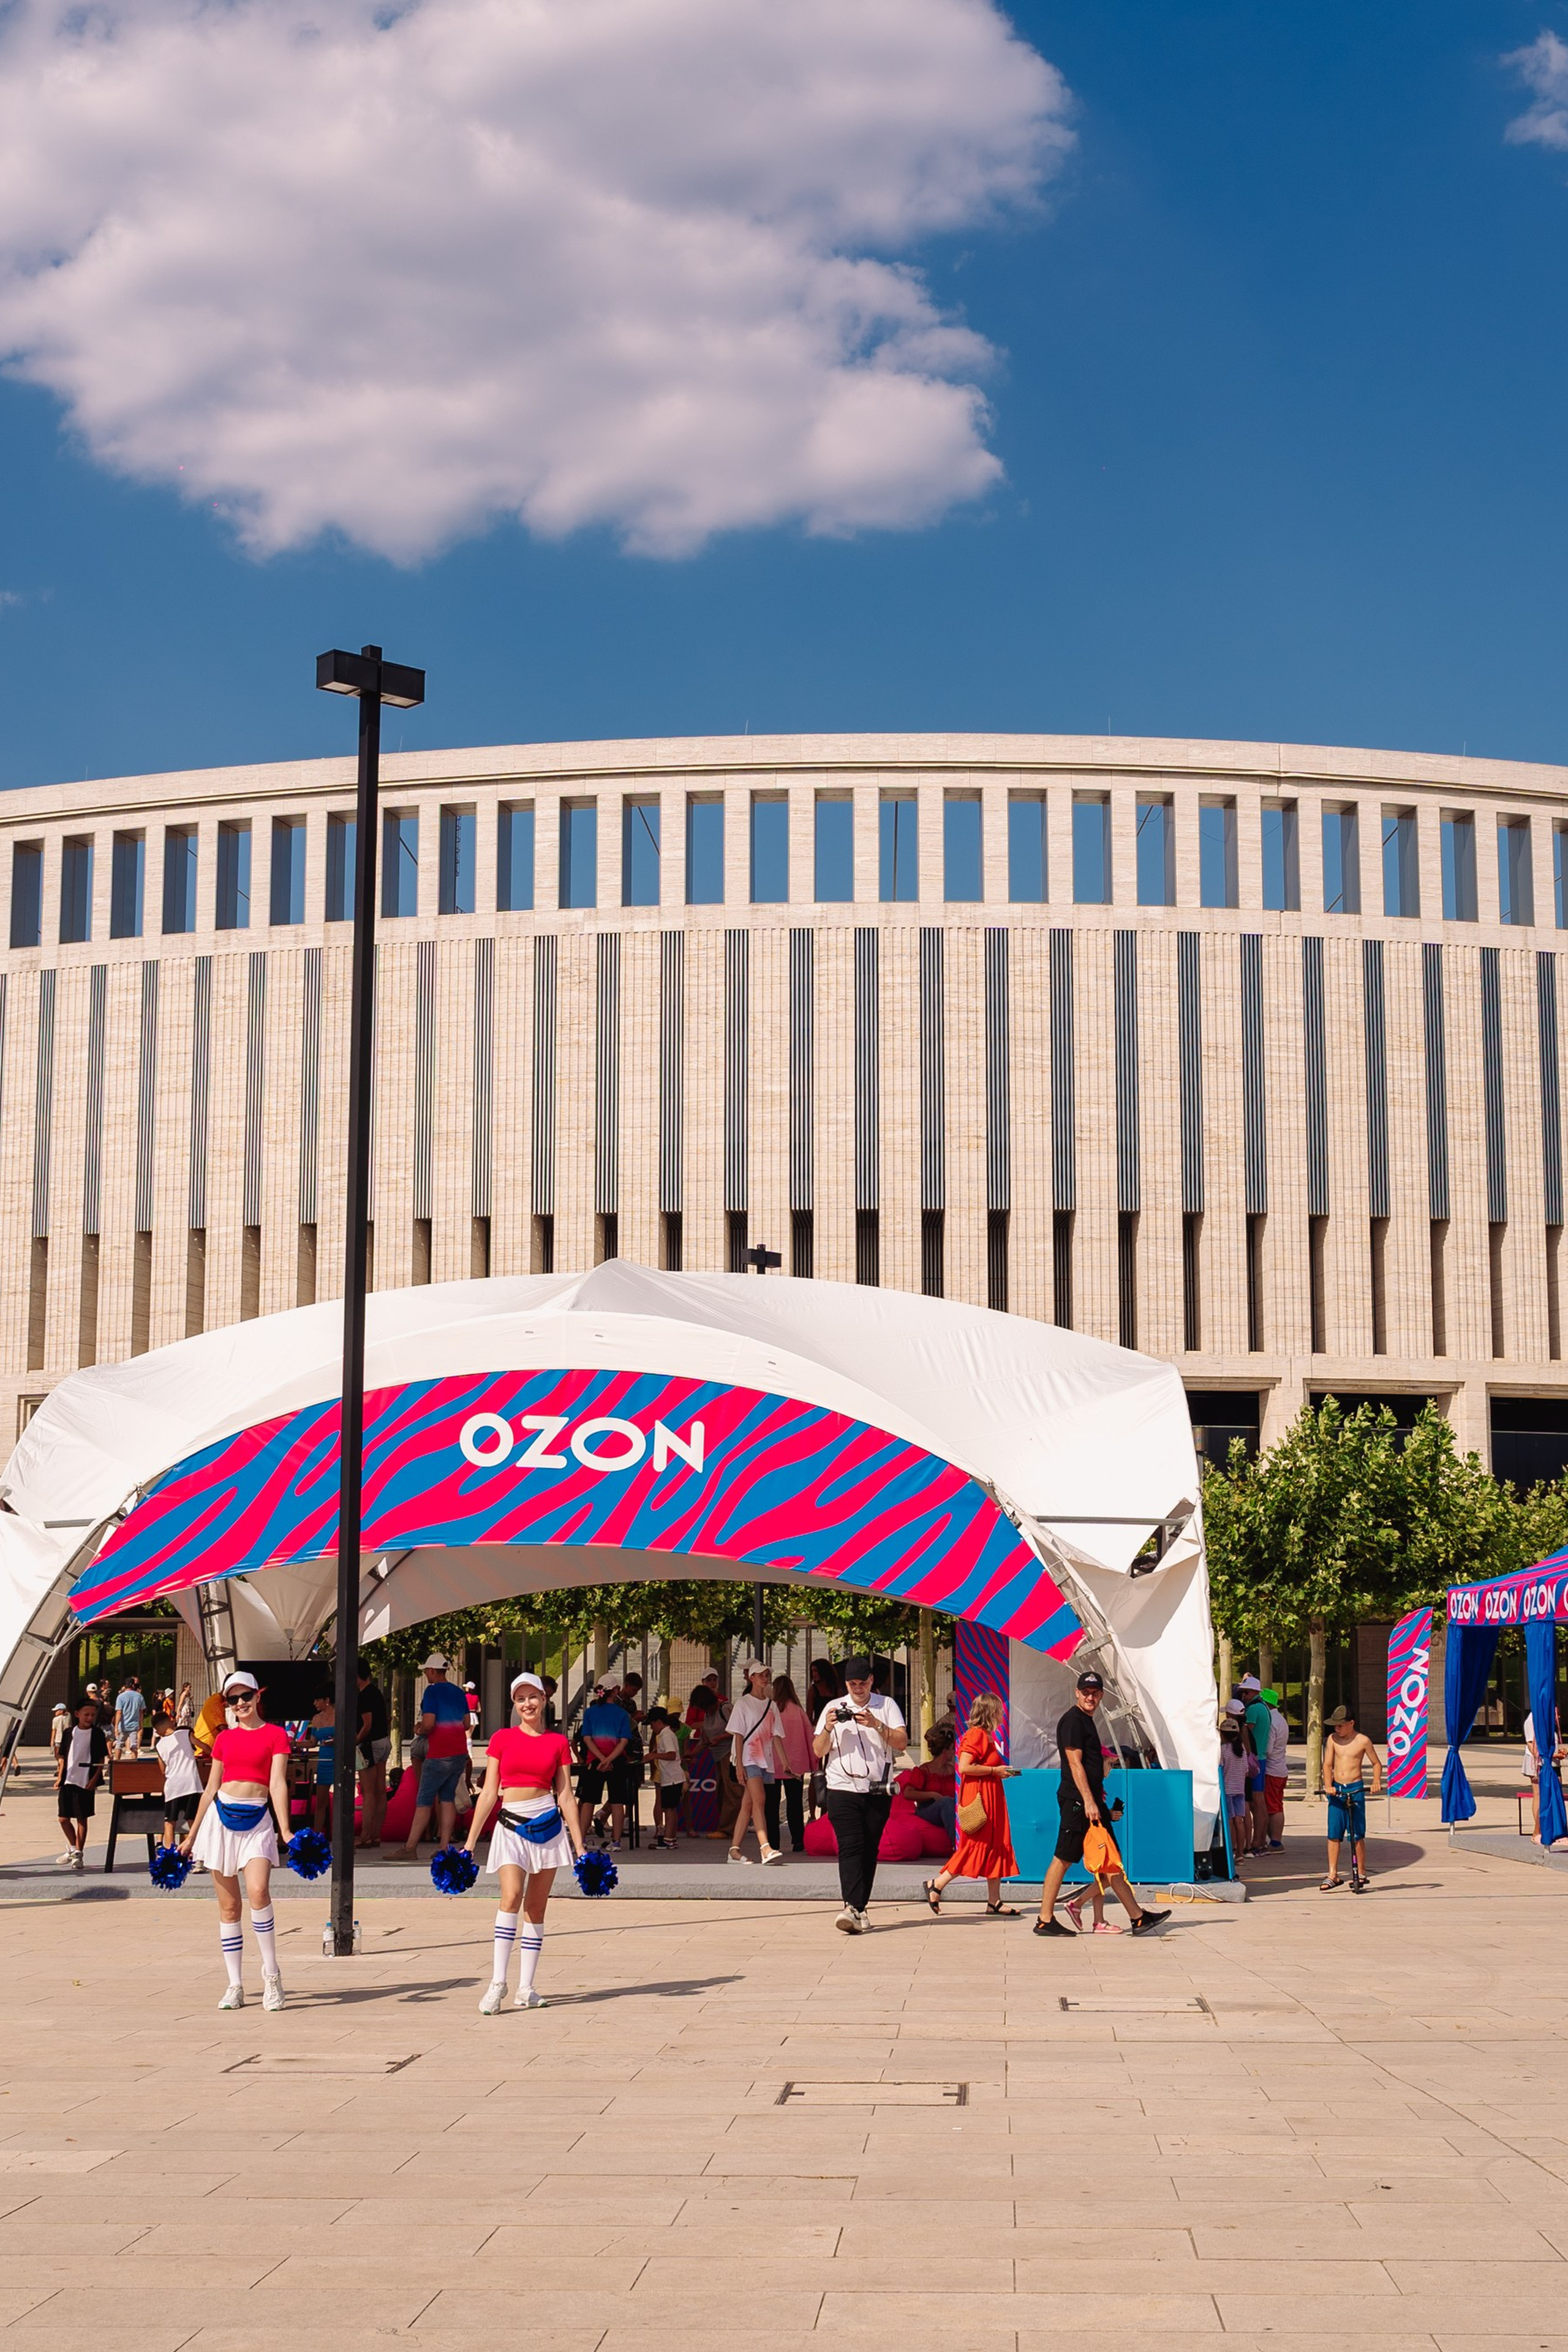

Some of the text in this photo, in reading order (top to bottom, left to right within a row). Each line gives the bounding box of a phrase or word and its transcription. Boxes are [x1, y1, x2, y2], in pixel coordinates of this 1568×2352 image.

[459, 1412, 705, 1474] OZON
[1450, 1592, 1479, 1619] OZON
[1485, 1590, 1517, 1619] OZON
[1523, 1584, 1556, 1617] OZON
[1389, 1647, 1429, 1755] OZON
[689, 1779, 717, 1792] ZO
